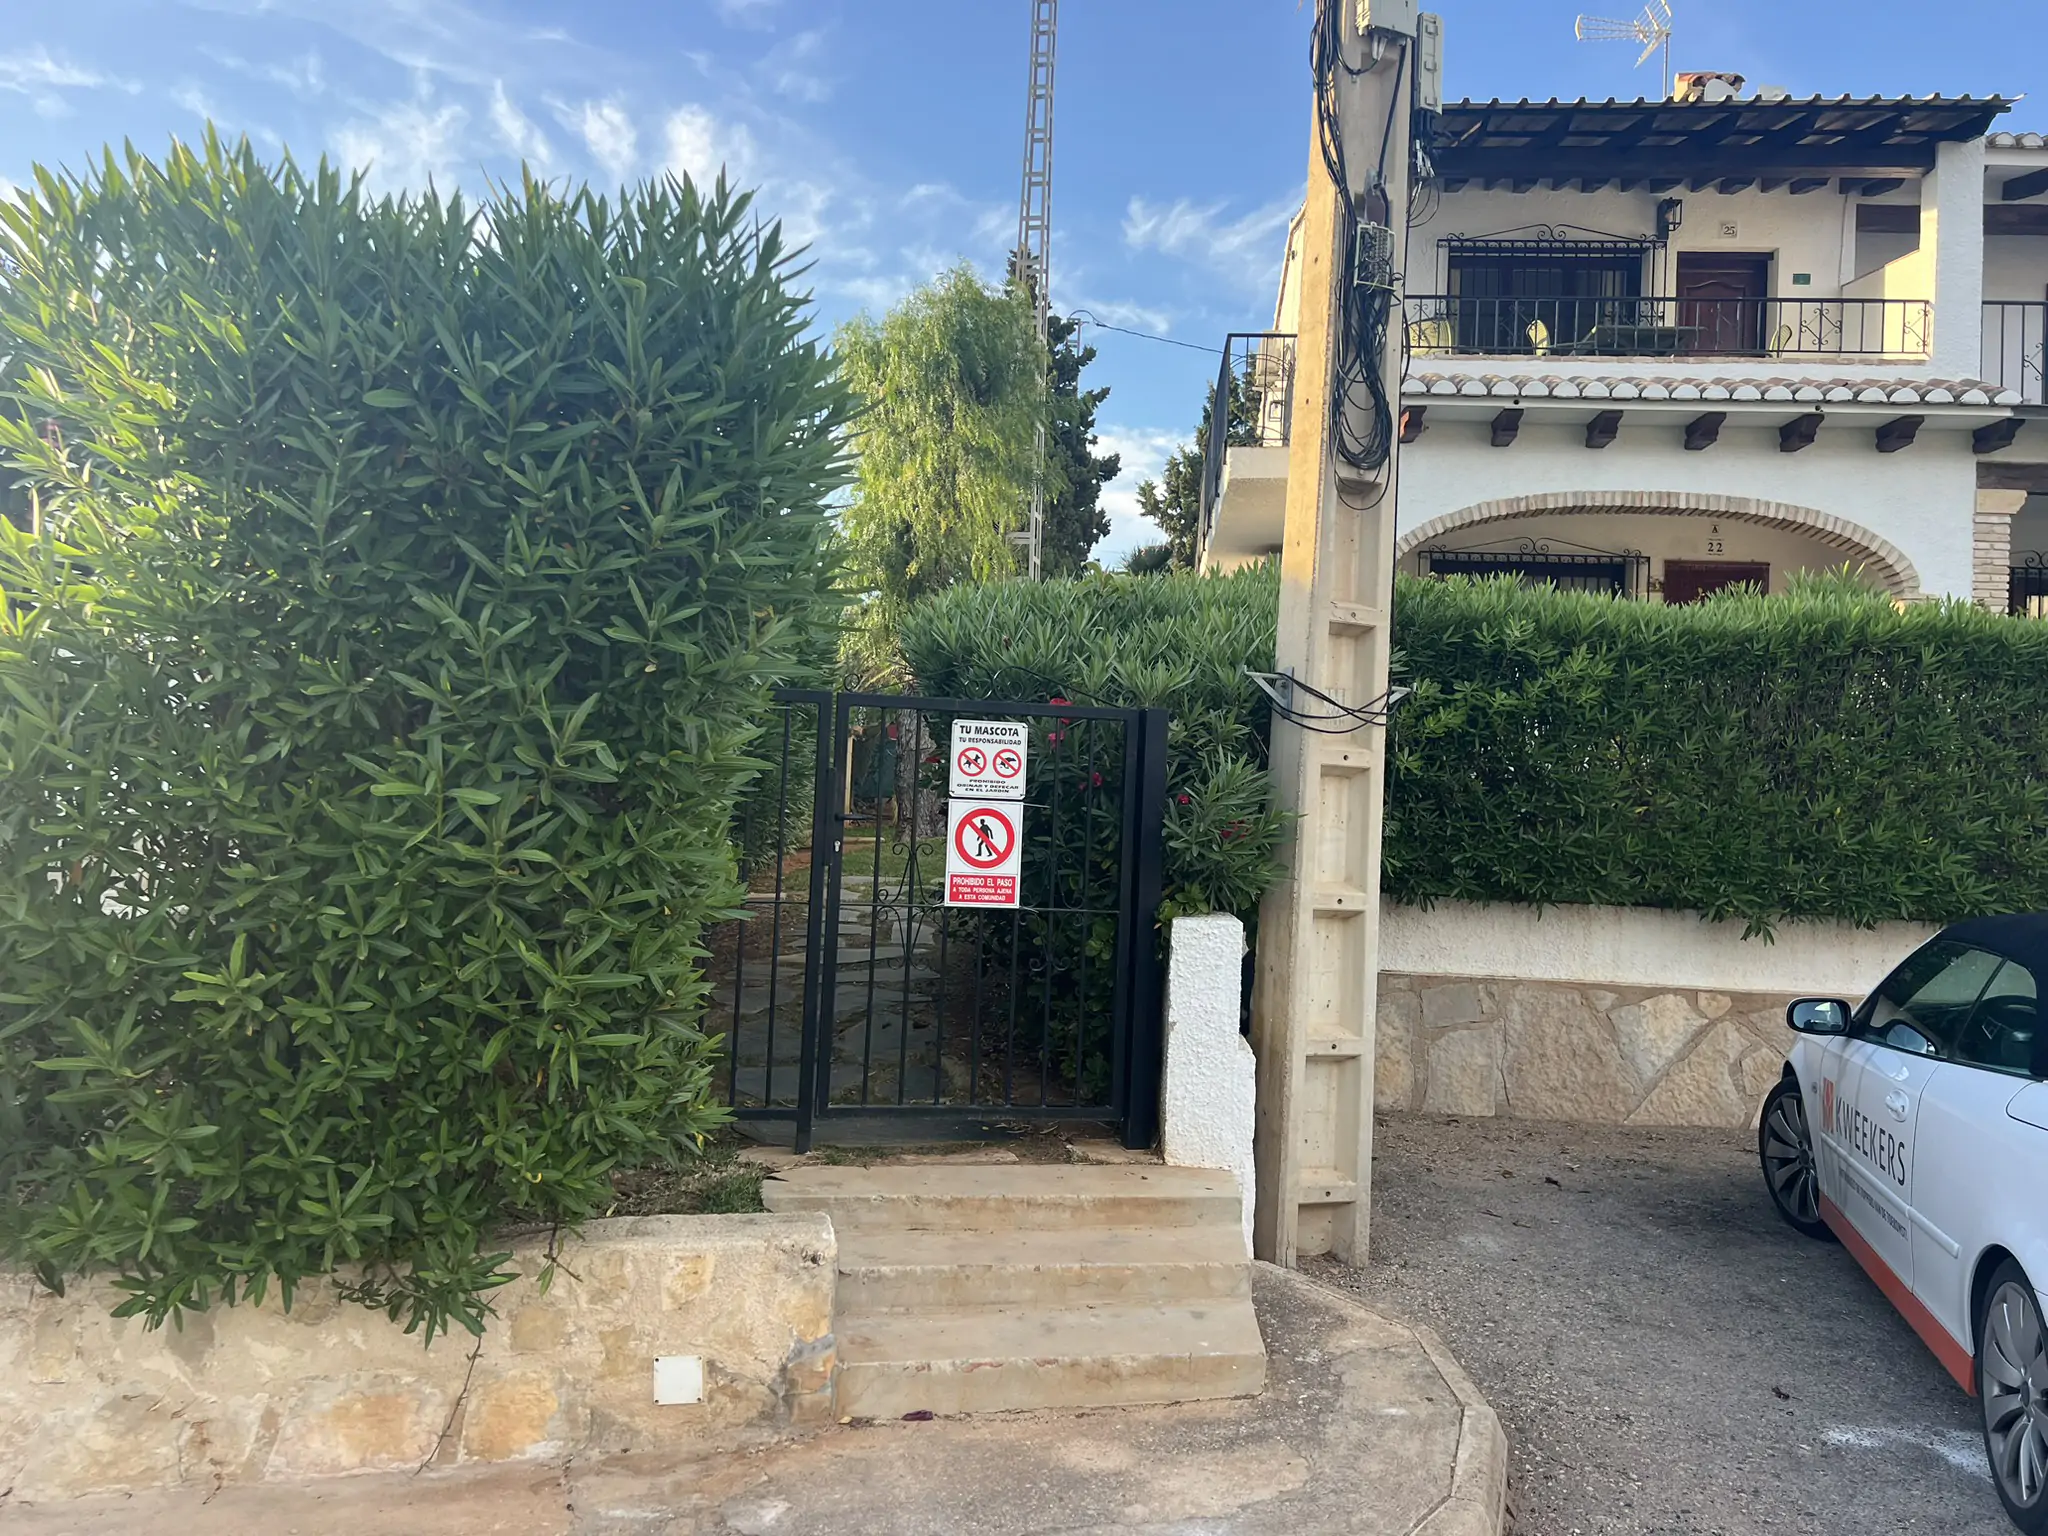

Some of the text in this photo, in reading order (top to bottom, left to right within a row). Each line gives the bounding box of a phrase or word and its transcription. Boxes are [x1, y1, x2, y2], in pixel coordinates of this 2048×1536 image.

[1724, 226, 1735, 235] 25
[959, 725, 1019, 737] TU MASCOTA
[968, 737, 1021, 745] RESPONSABILIDAD
[952, 877, 1013, 887] PROHIBIDO EL PASO
[1835, 1096, 1906, 1186] KWEEKERS
